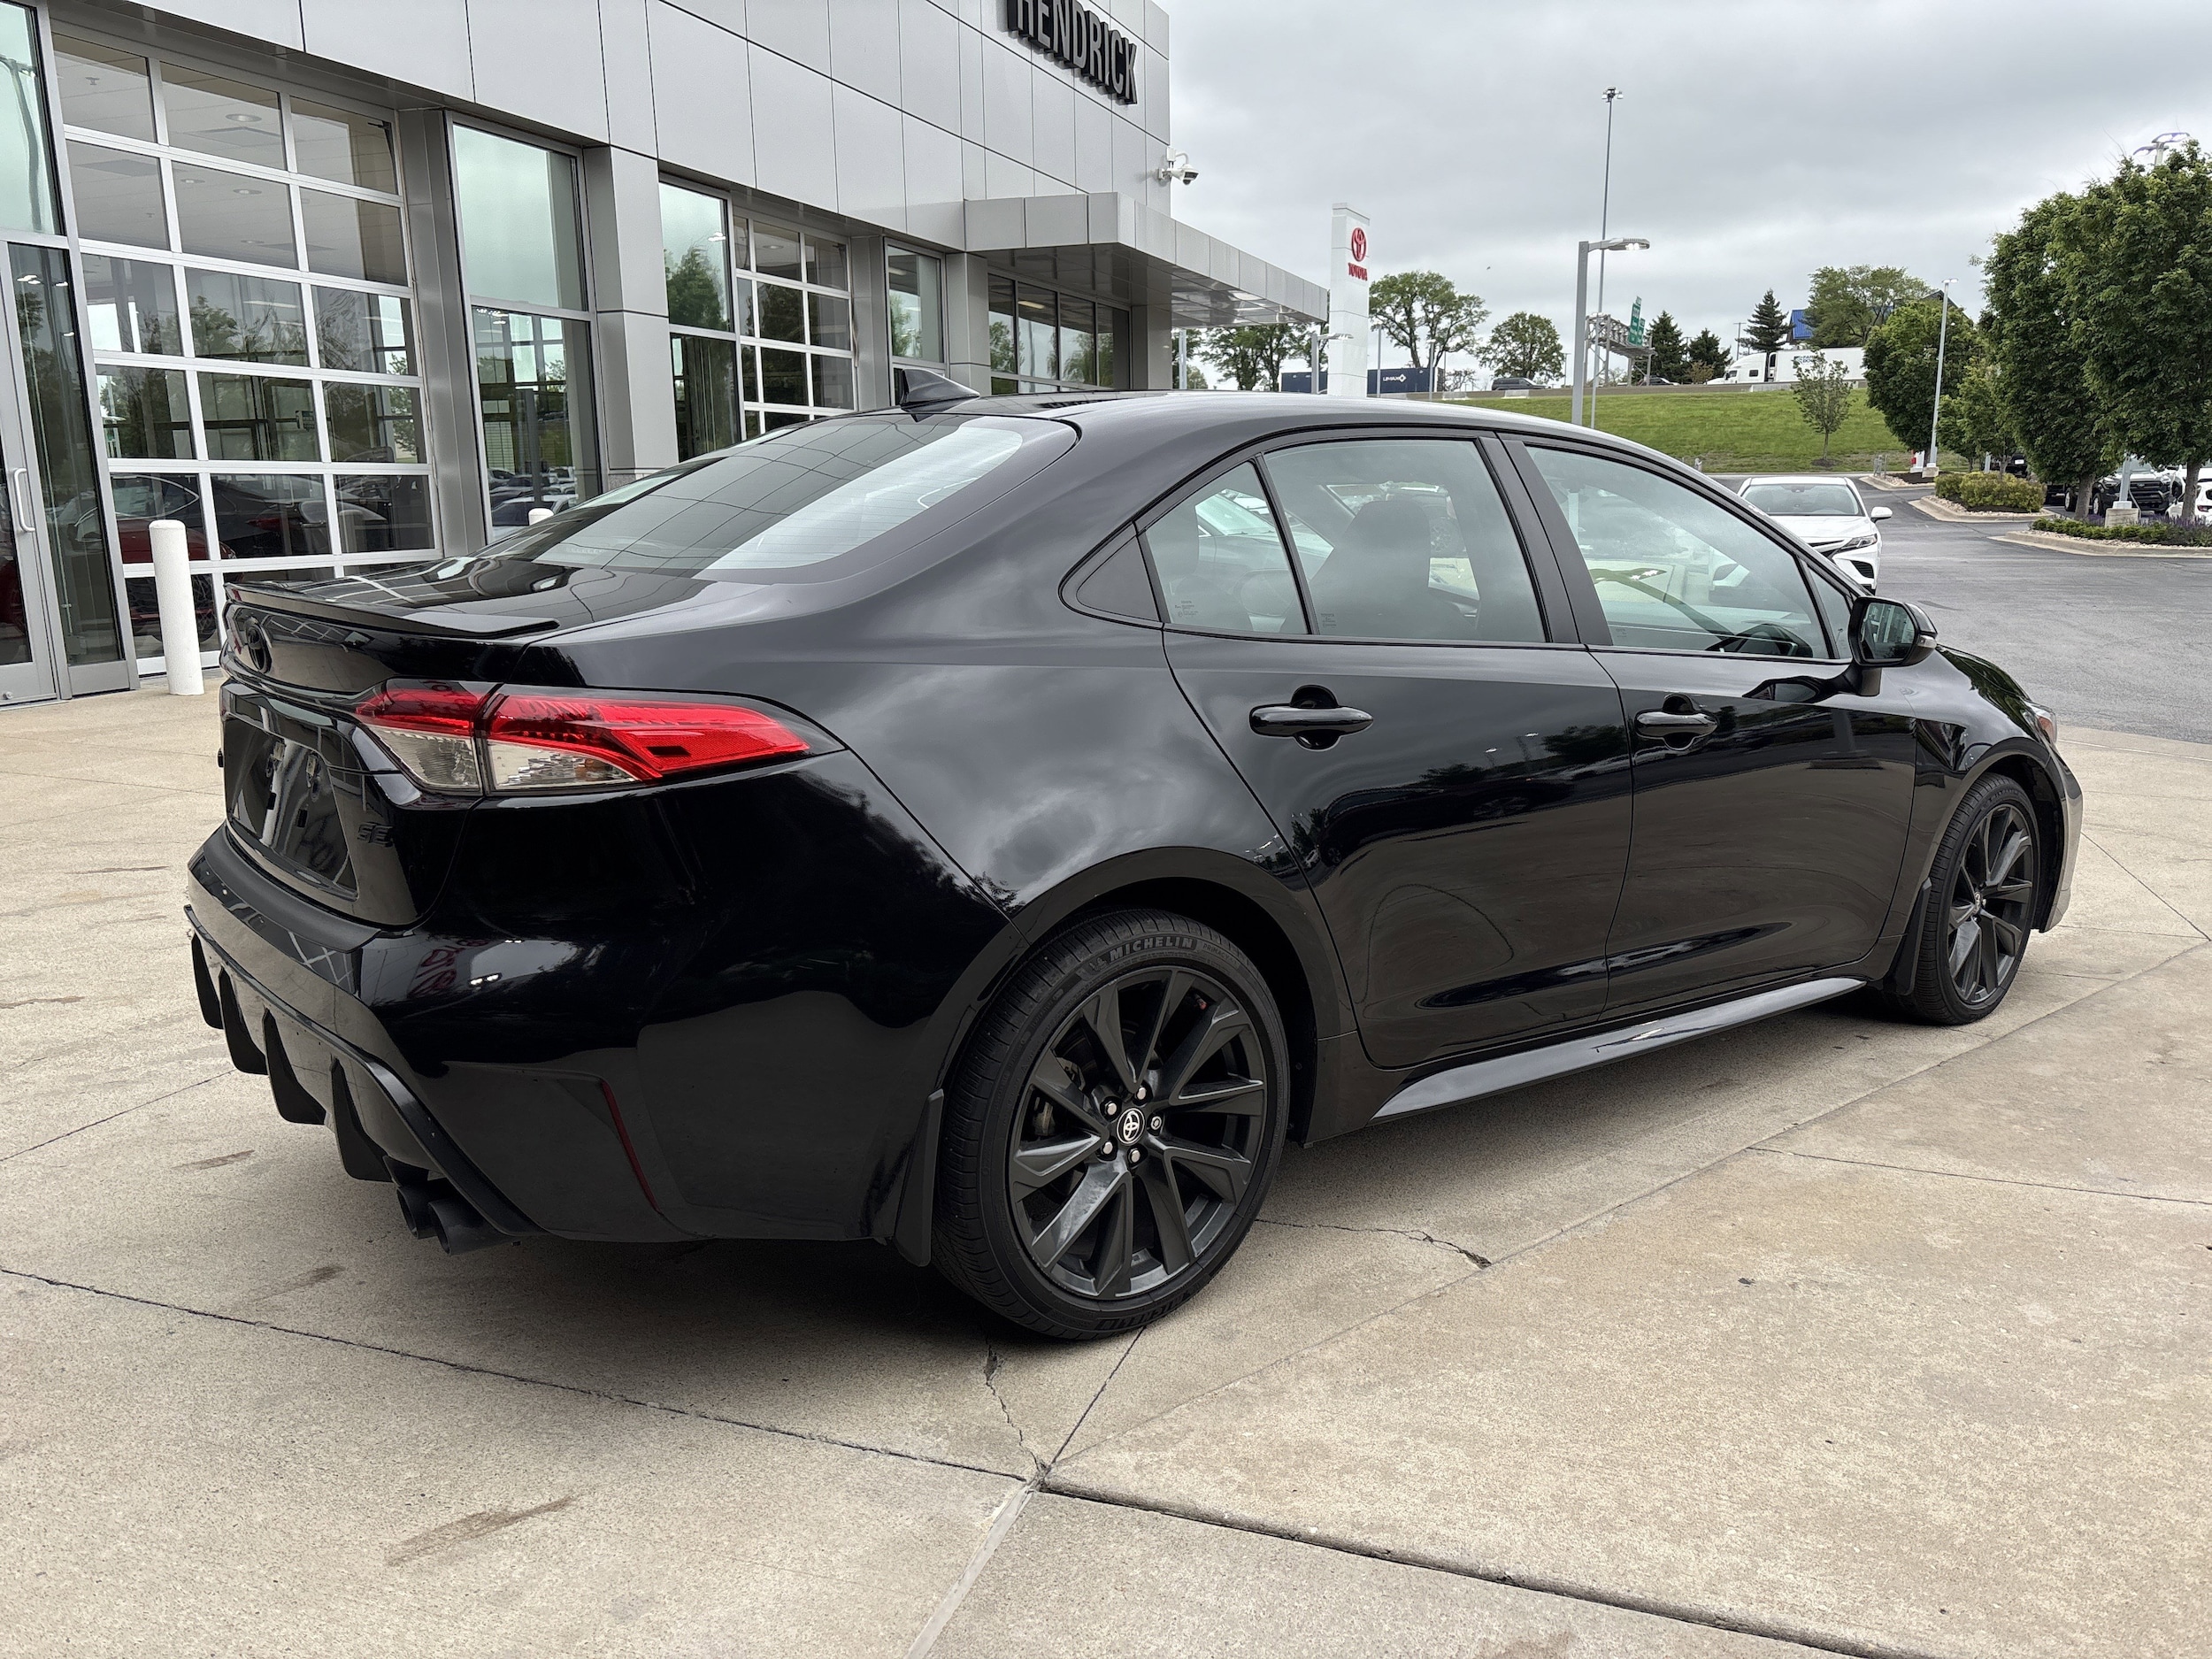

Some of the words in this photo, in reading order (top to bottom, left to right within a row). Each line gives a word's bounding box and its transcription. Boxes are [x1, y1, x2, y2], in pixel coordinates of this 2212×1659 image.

[1009, 0, 1137, 104] HENDRICK
[1348, 262, 1368, 281] TOYOTA
[357, 822, 394, 847] SE
[1109, 936, 1194, 962] MICHELIN
